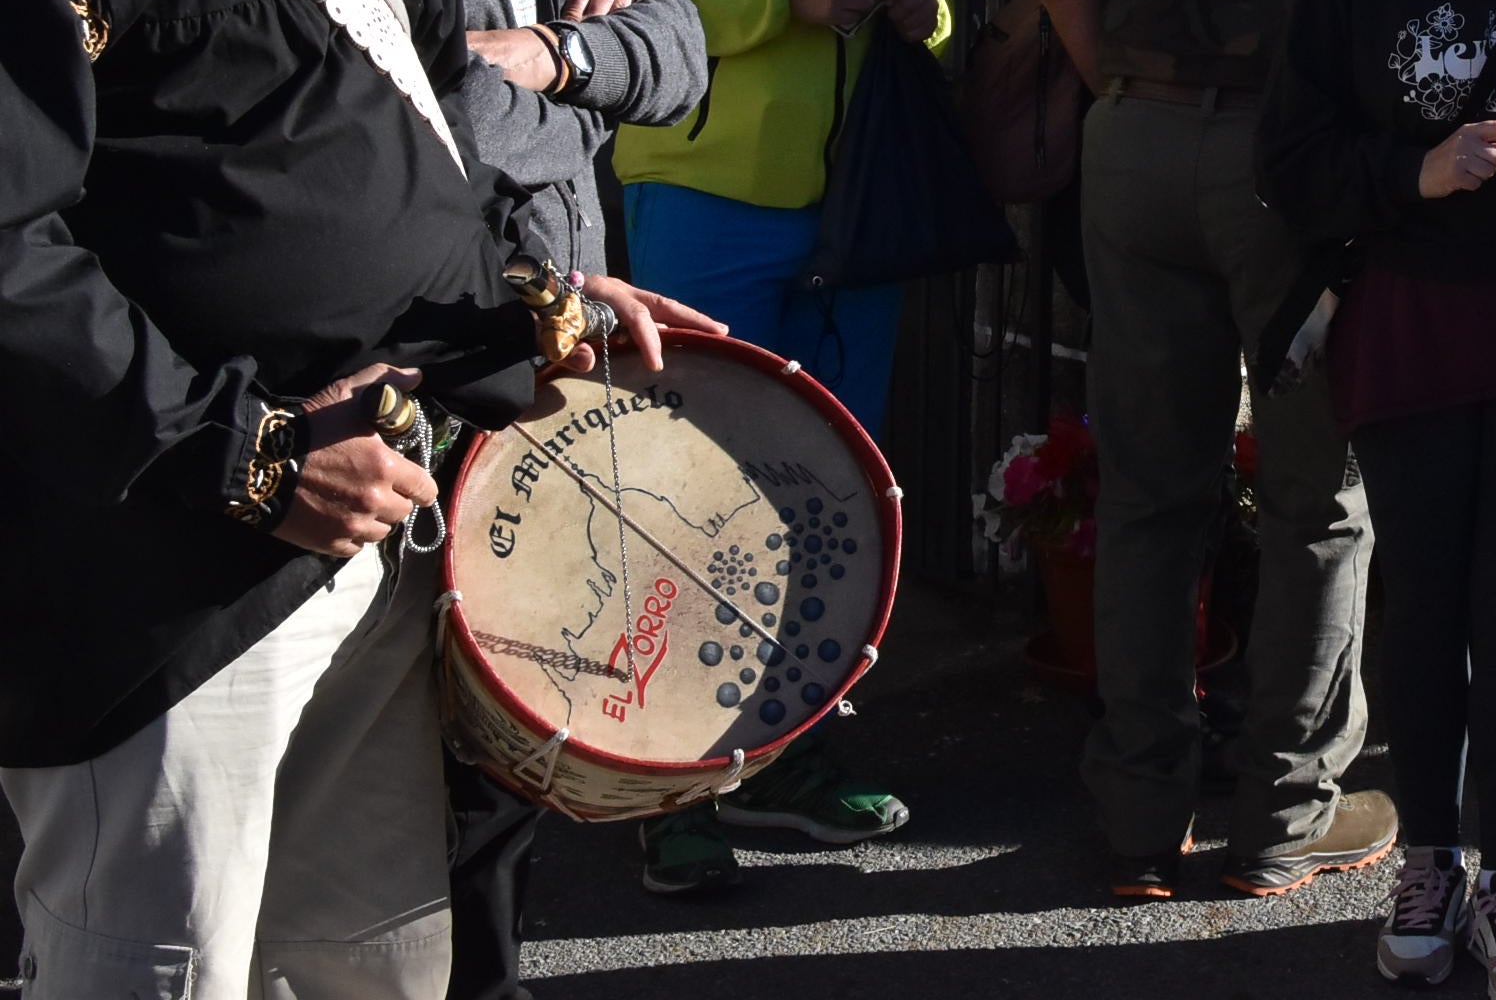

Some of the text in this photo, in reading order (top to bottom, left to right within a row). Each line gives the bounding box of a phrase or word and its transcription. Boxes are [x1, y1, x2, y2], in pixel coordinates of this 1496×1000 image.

[488, 384, 684, 559] El Mariquelo
[602, 577, 677, 723] EL ZORRO
